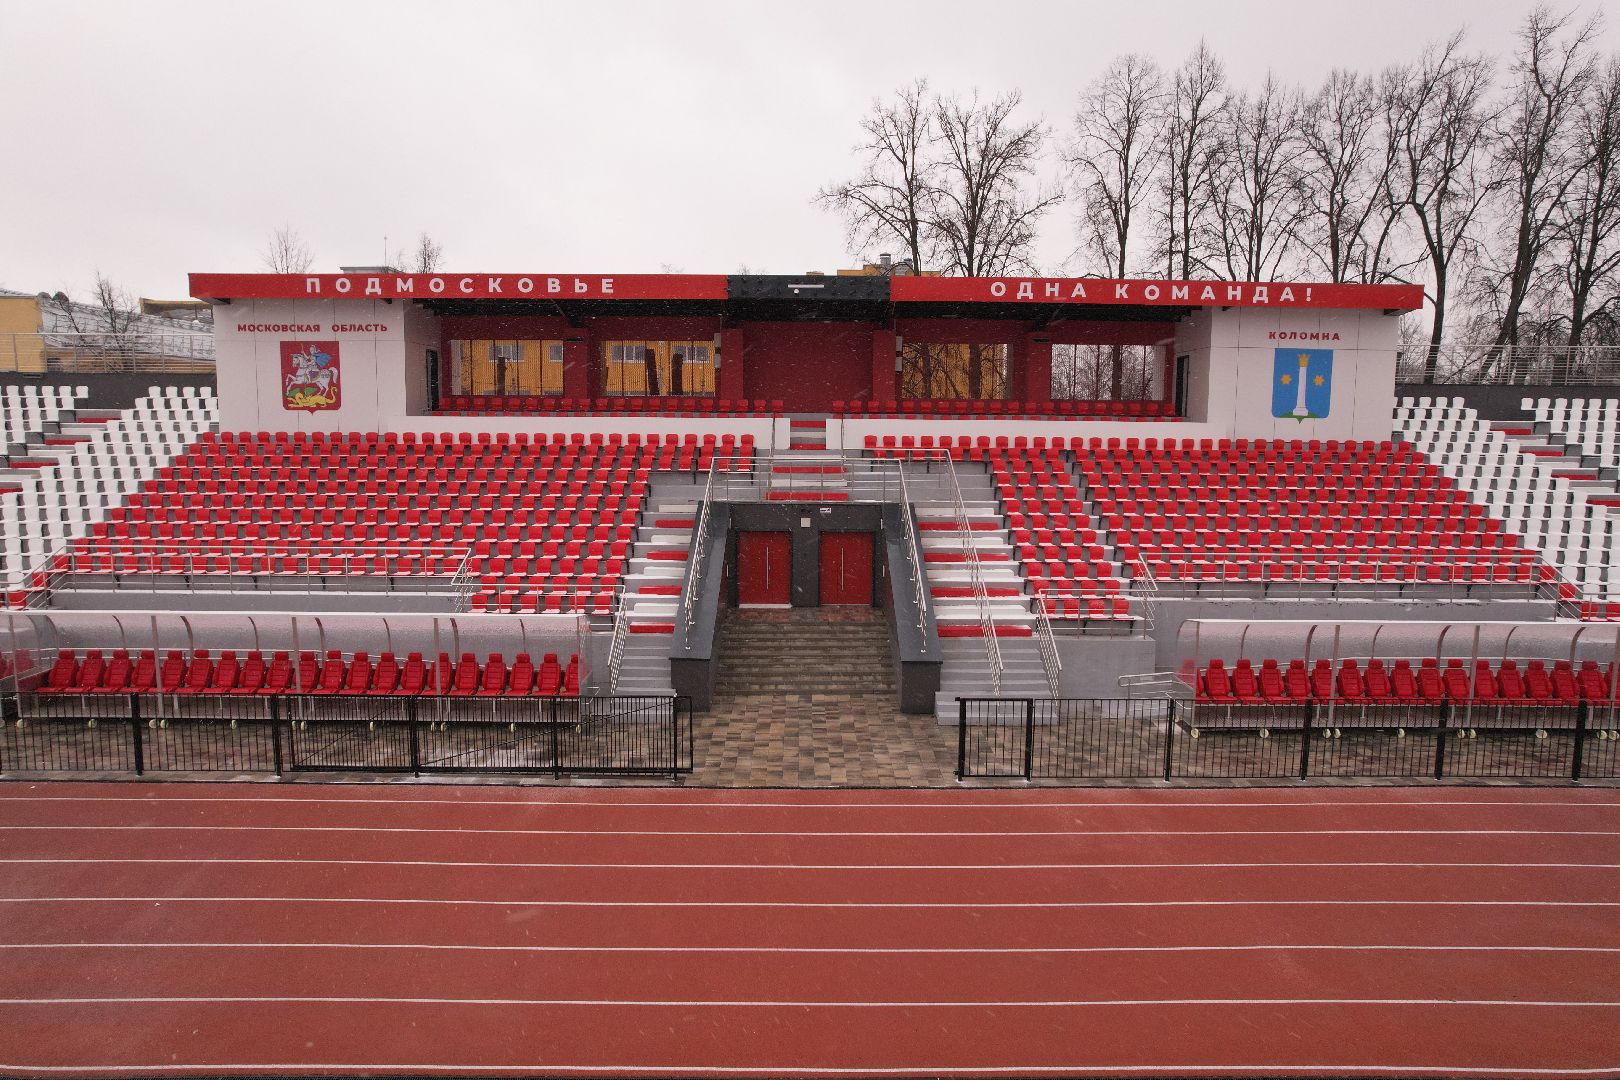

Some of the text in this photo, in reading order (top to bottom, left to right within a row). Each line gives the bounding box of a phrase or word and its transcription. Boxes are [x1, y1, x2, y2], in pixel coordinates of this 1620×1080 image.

[306, 277, 614, 295] ПОДМОСКОВЬЕ
[990, 281, 1312, 303] ОДНА КОМАНДА!
[237, 323, 388, 332] МОСКОВСКАЯ ОБЛАСТЬ
[1268, 331, 1340, 341] КОЛОМНА
